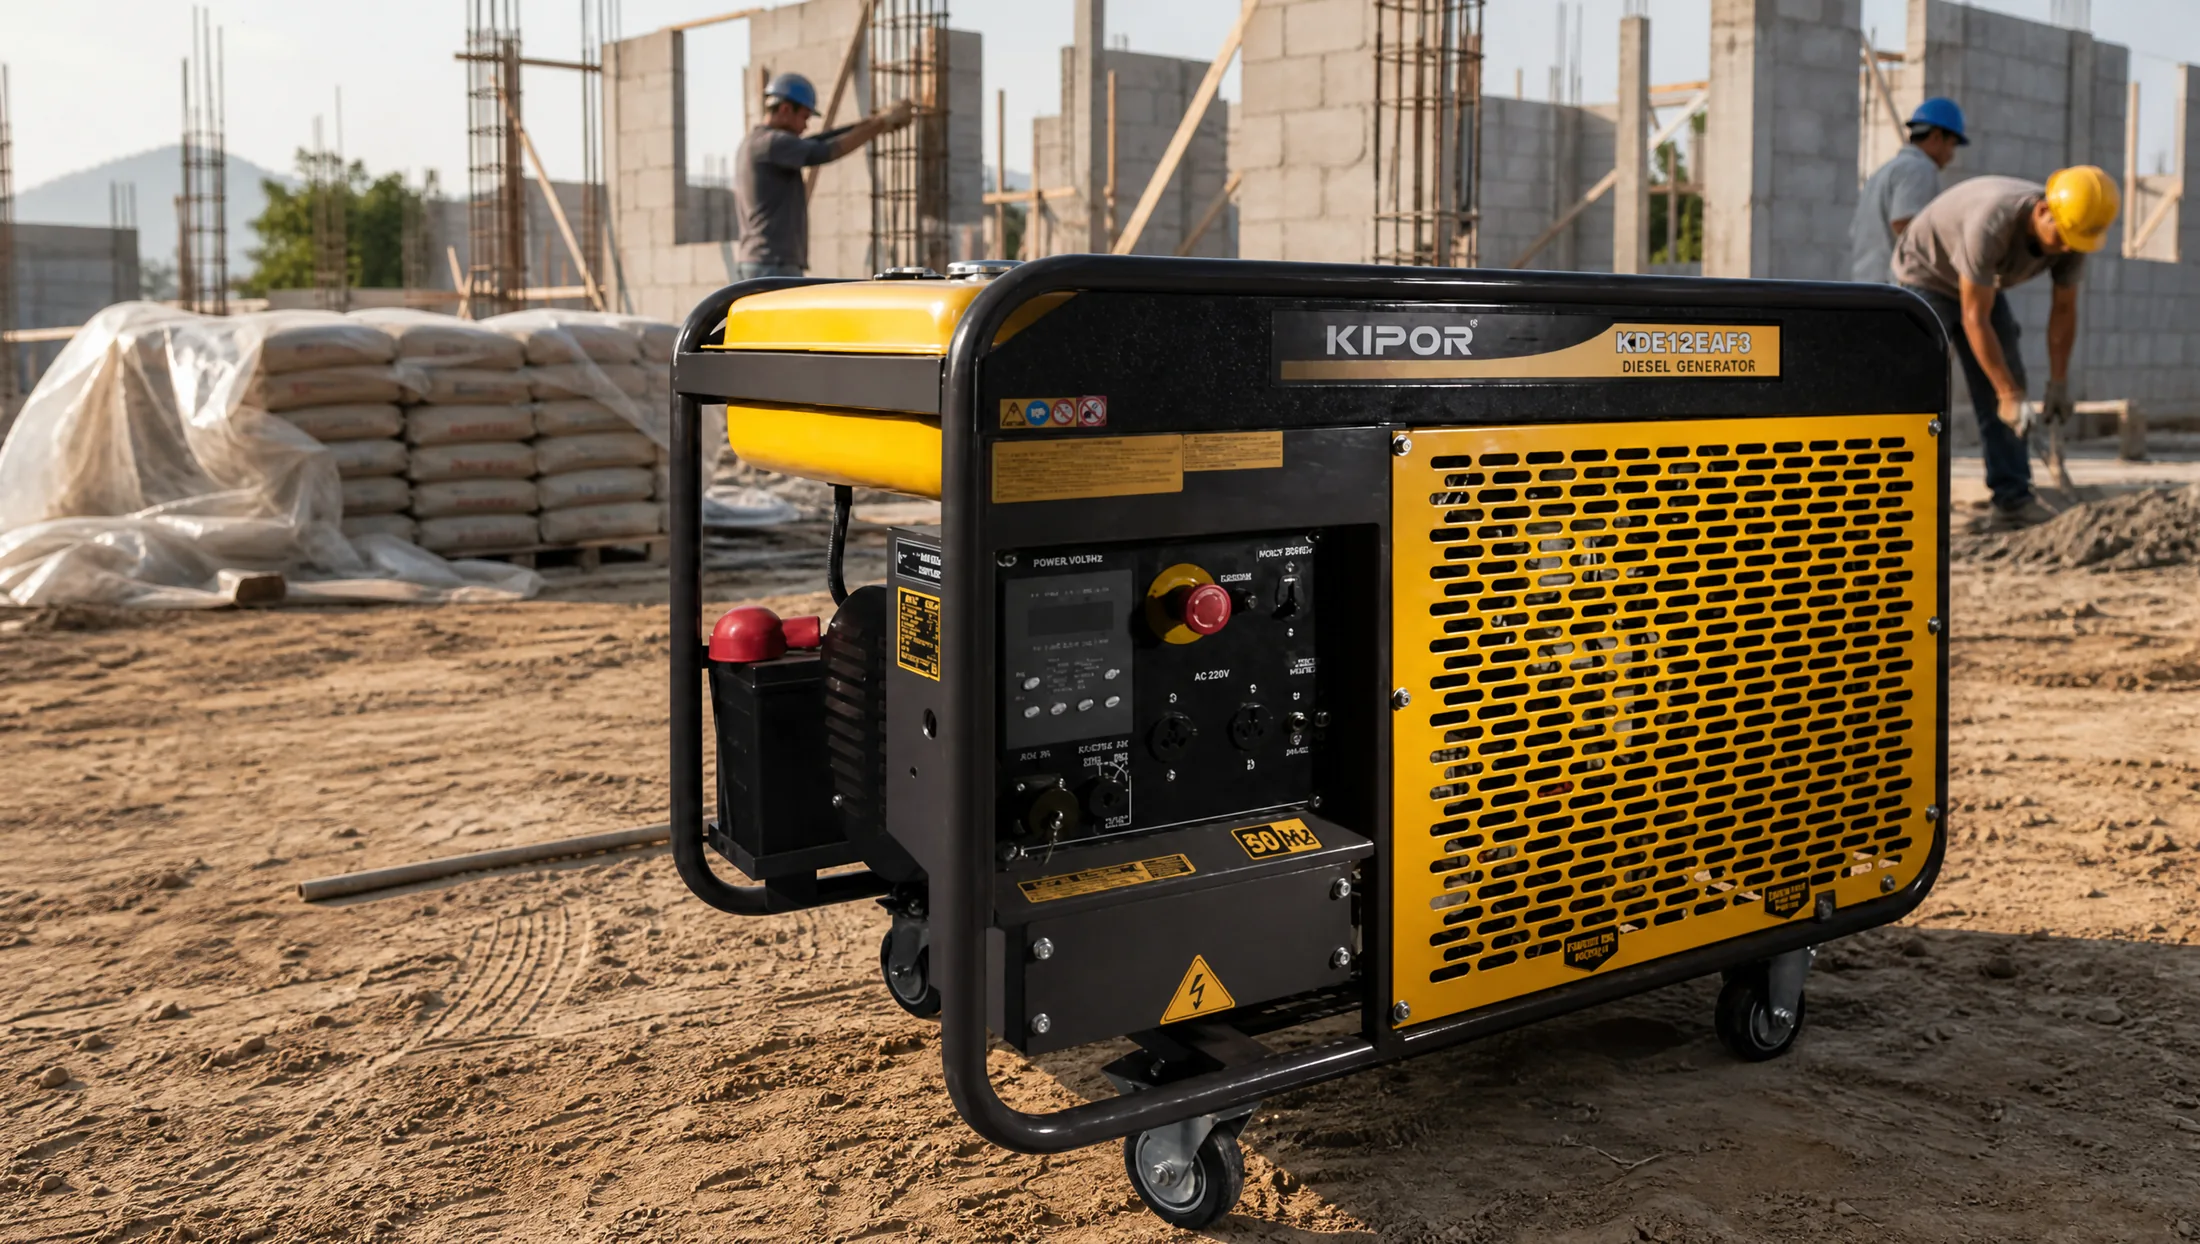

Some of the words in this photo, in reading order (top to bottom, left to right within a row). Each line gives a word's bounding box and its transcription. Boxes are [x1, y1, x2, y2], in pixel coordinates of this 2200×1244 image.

[1326, 325, 1474, 356] KIPOR
[1616, 331, 1752, 354] KDE12EAF3
[1623, 360, 1671, 373] DIESEL
[1676, 360, 1756, 373] GENERATOR
[1033, 556, 1068, 568] POWER
[1194, 672, 1207, 681] AC
[1208, 669, 1230, 680] 220V
